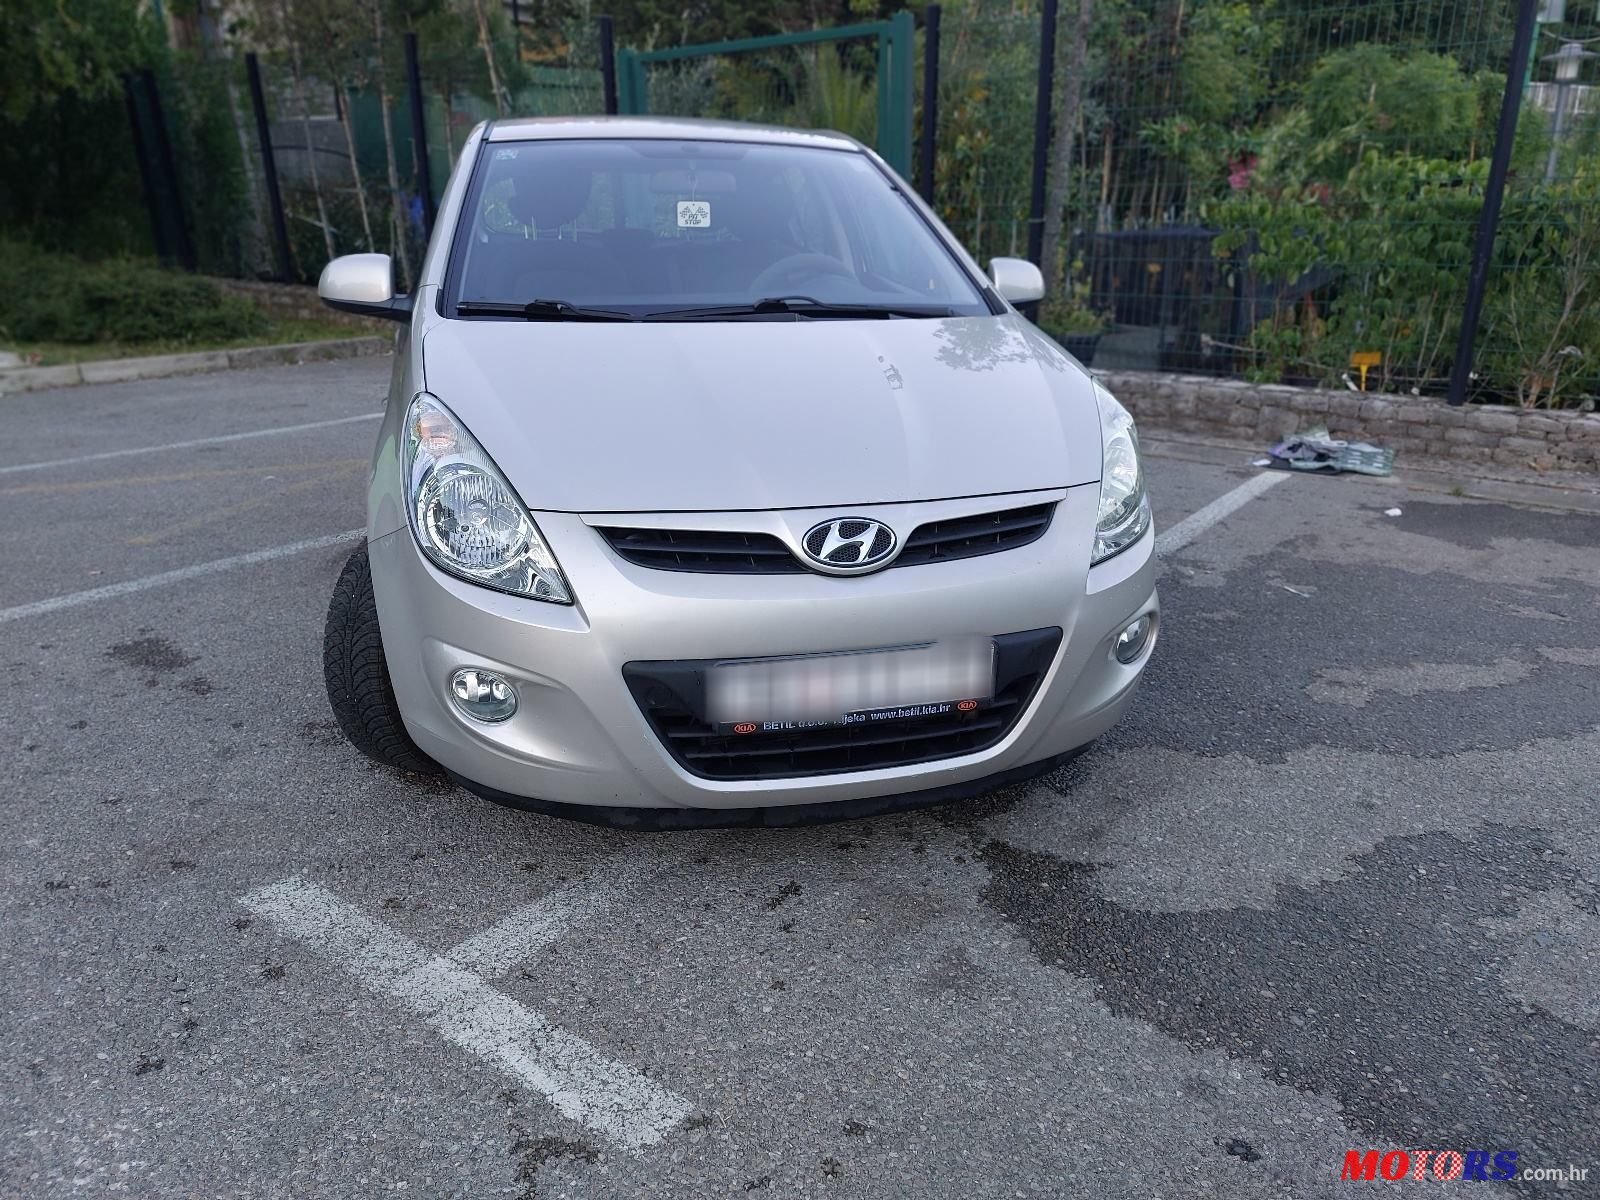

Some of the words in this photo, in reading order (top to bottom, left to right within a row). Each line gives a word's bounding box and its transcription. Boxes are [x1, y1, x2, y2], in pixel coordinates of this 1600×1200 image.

[736, 723, 755, 733] KIA
[832, 712, 866, 726] ijeka
[870, 703, 951, 721] www.betil.kia.hr
[959, 700, 977, 711] KIA
